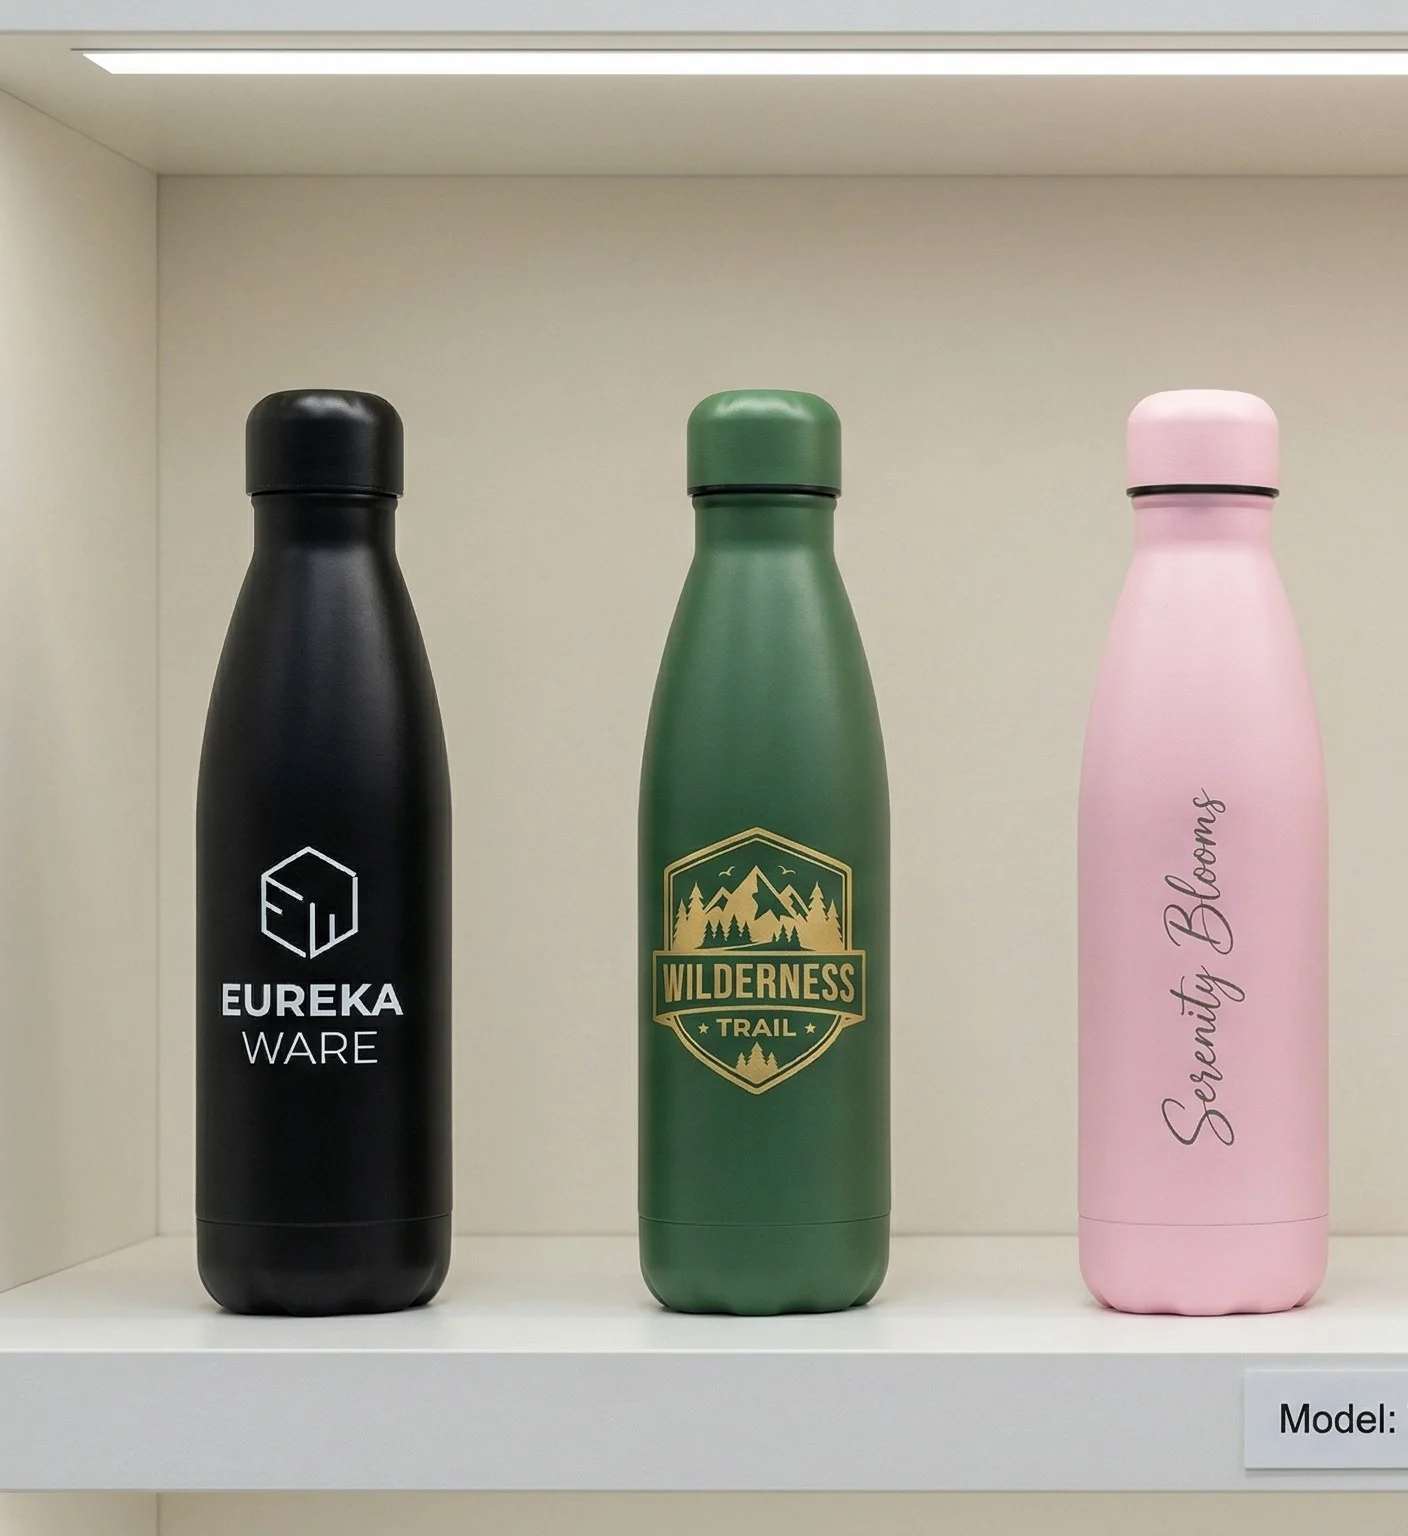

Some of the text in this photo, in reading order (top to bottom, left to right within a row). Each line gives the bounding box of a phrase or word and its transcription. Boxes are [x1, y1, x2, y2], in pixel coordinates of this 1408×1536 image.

[662, 963, 855, 1003] WILDERNESS
[1161, 788, 1245, 1146] Serenity Blooms
[222, 983, 404, 1017] EUREKA
[716, 1018, 797, 1037] TRAIL
[242, 1031, 378, 1064] WARE
[1280, 1403, 1396, 1433] Model:
